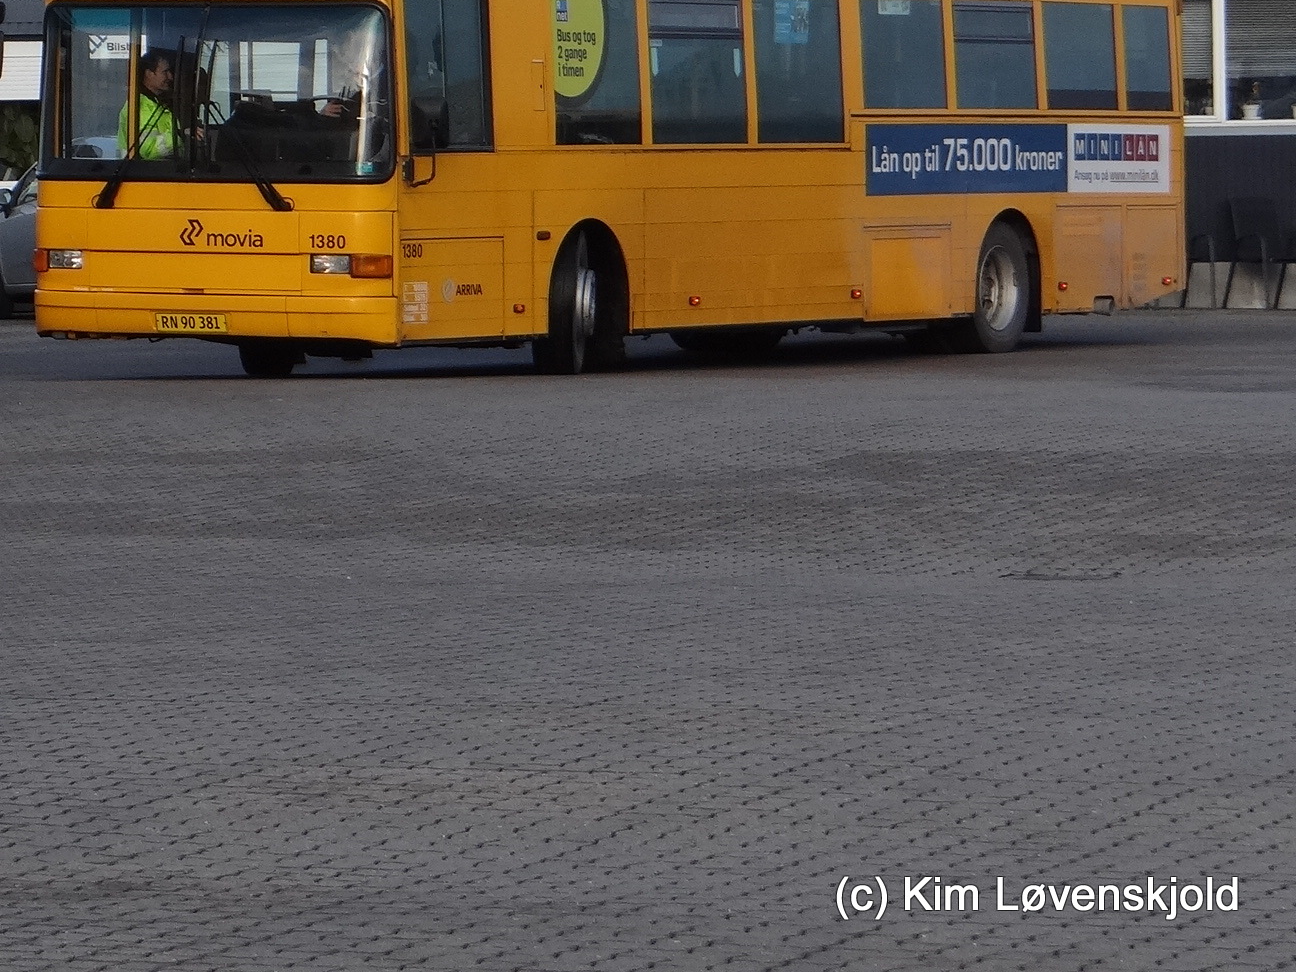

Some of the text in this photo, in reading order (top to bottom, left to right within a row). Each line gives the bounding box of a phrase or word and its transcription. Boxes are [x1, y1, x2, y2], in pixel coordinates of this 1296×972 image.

[557, 29, 596, 45] Bus og tog
[107, 43, 129, 51] Bils
[558, 46, 587, 62] 2 gange
[562, 63, 584, 77] timen
[872, 138, 1062, 179] Lån op til 75.000 kroner
[207, 229, 263, 247] movia
[309, 234, 346, 249] 1380
[403, 244, 422, 258] 1380
[456, 284, 482, 296] ARRIVA
[162, 316, 220, 329] RN 90 381
